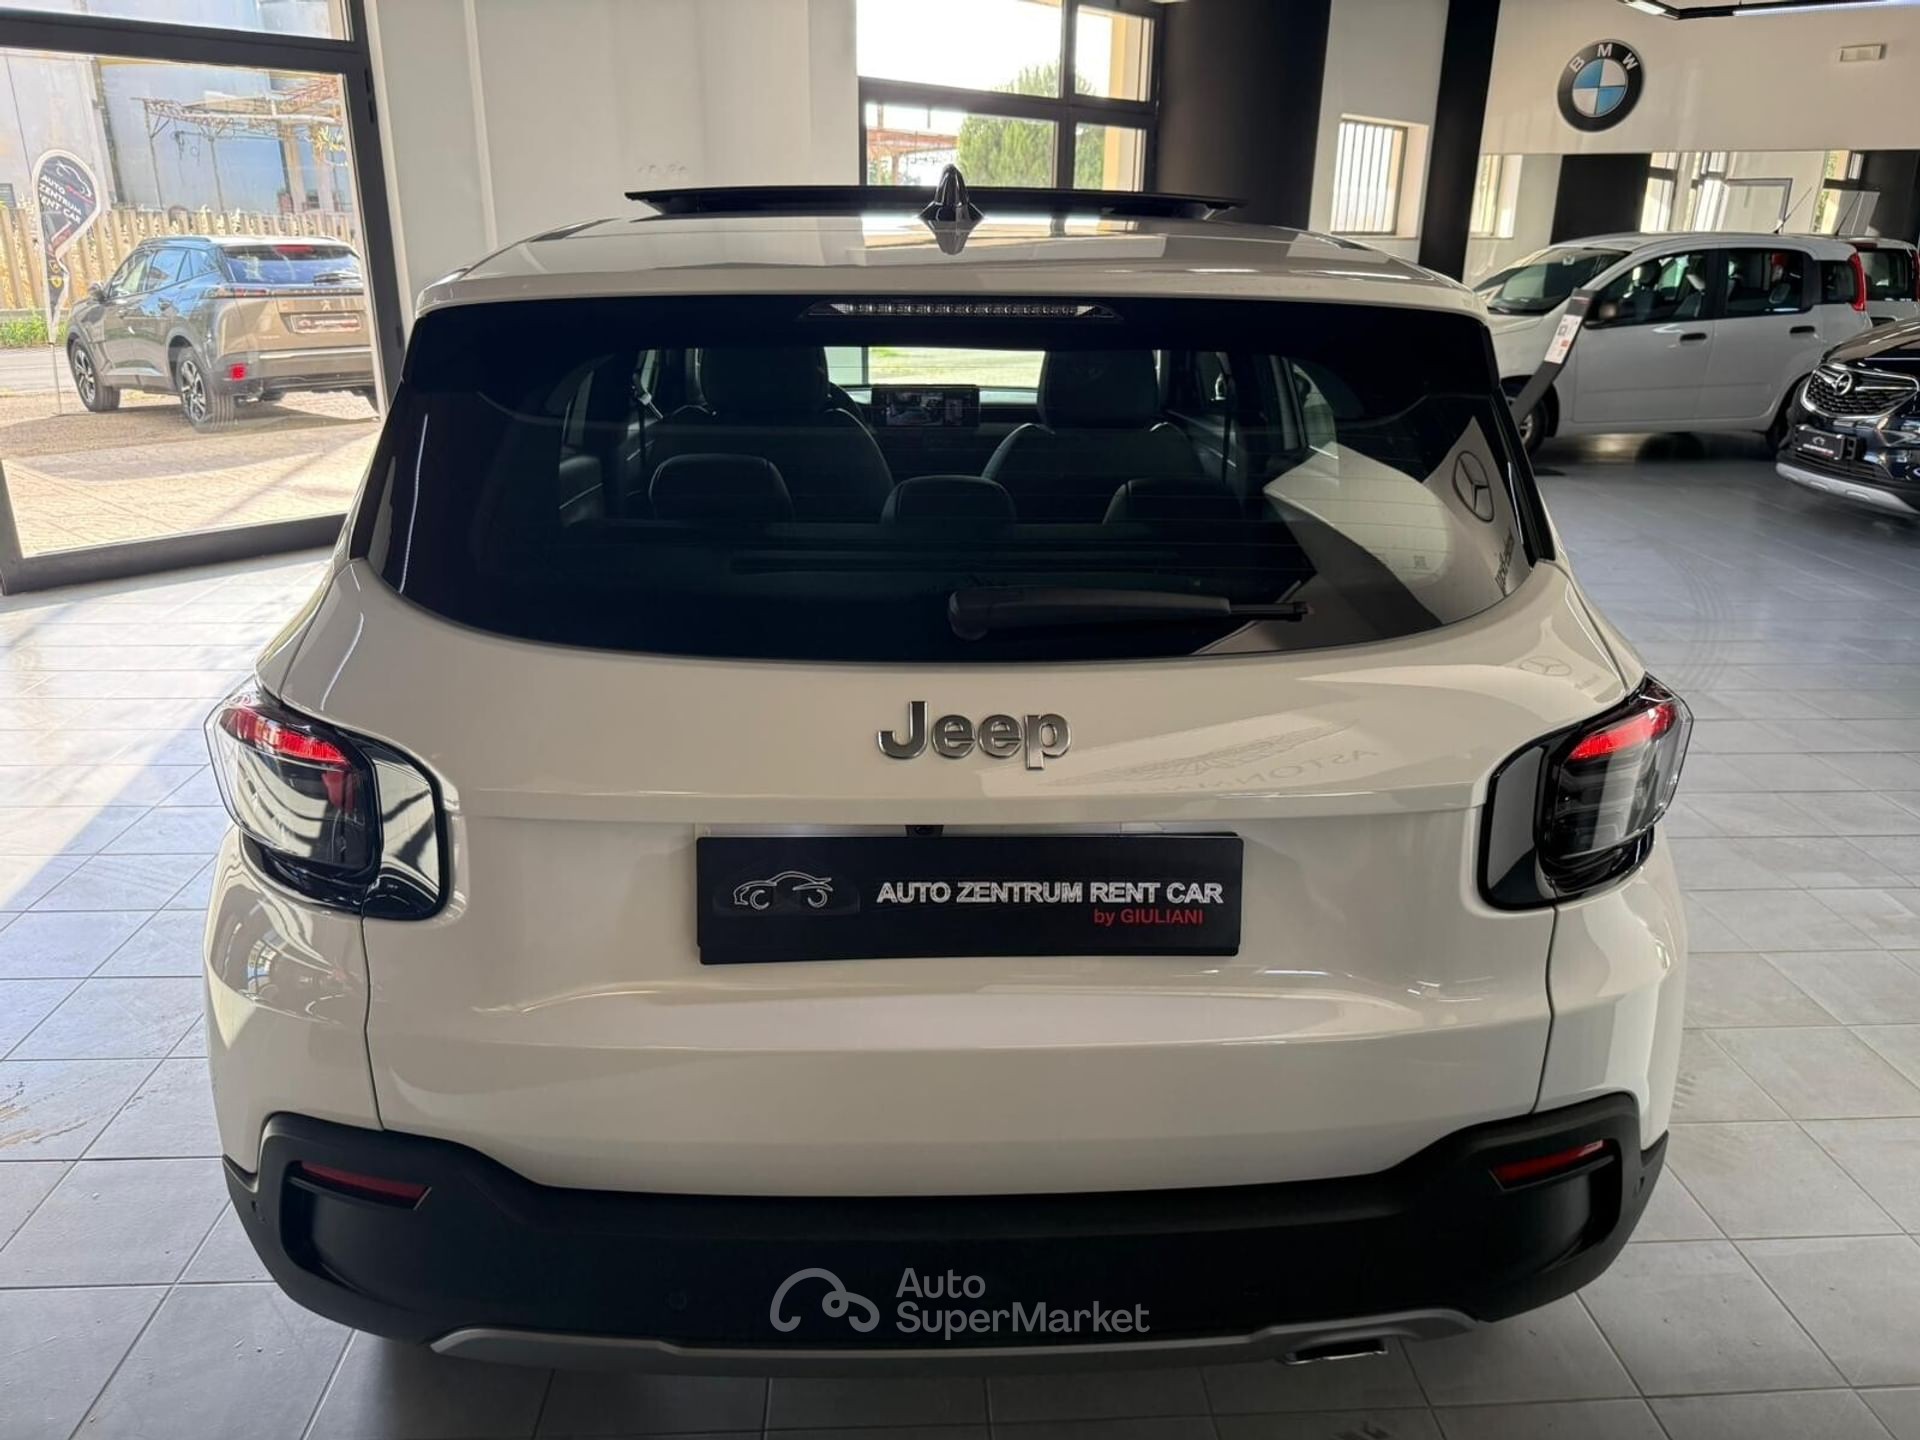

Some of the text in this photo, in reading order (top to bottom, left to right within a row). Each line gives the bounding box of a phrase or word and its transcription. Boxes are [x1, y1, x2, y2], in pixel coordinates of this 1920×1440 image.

[1568, 43, 1638, 73] BMW
[40, 174, 66, 195] AUTO
[39, 183, 82, 215] ZENTRUM
[63, 206, 81, 224] CAR
[877, 700, 1072, 770] Jeep
[876, 881, 1224, 904] AUTO ZENTRUM RENT CAR
[1093, 907, 1204, 927] by GIULIANI
